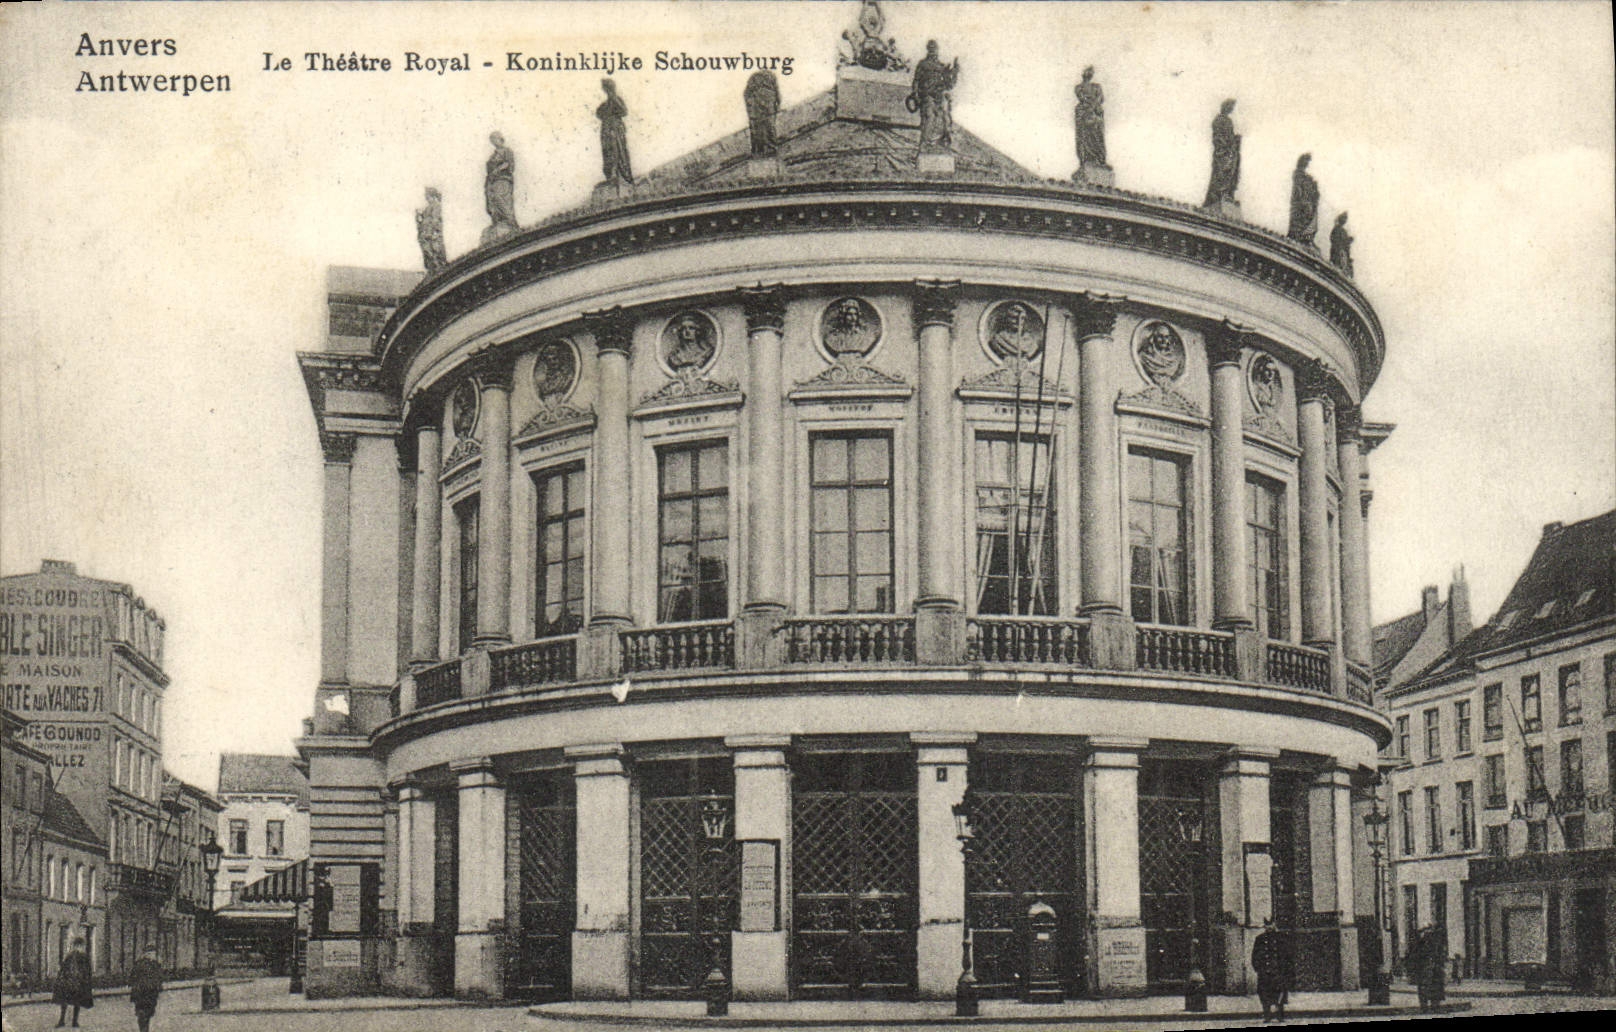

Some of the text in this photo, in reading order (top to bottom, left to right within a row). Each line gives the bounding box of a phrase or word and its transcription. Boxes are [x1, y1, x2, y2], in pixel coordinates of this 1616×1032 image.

[37, 613, 103, 658] SINGER
[19, 663, 82, 678] MAISON
[46, 684, 89, 712] VACHES
